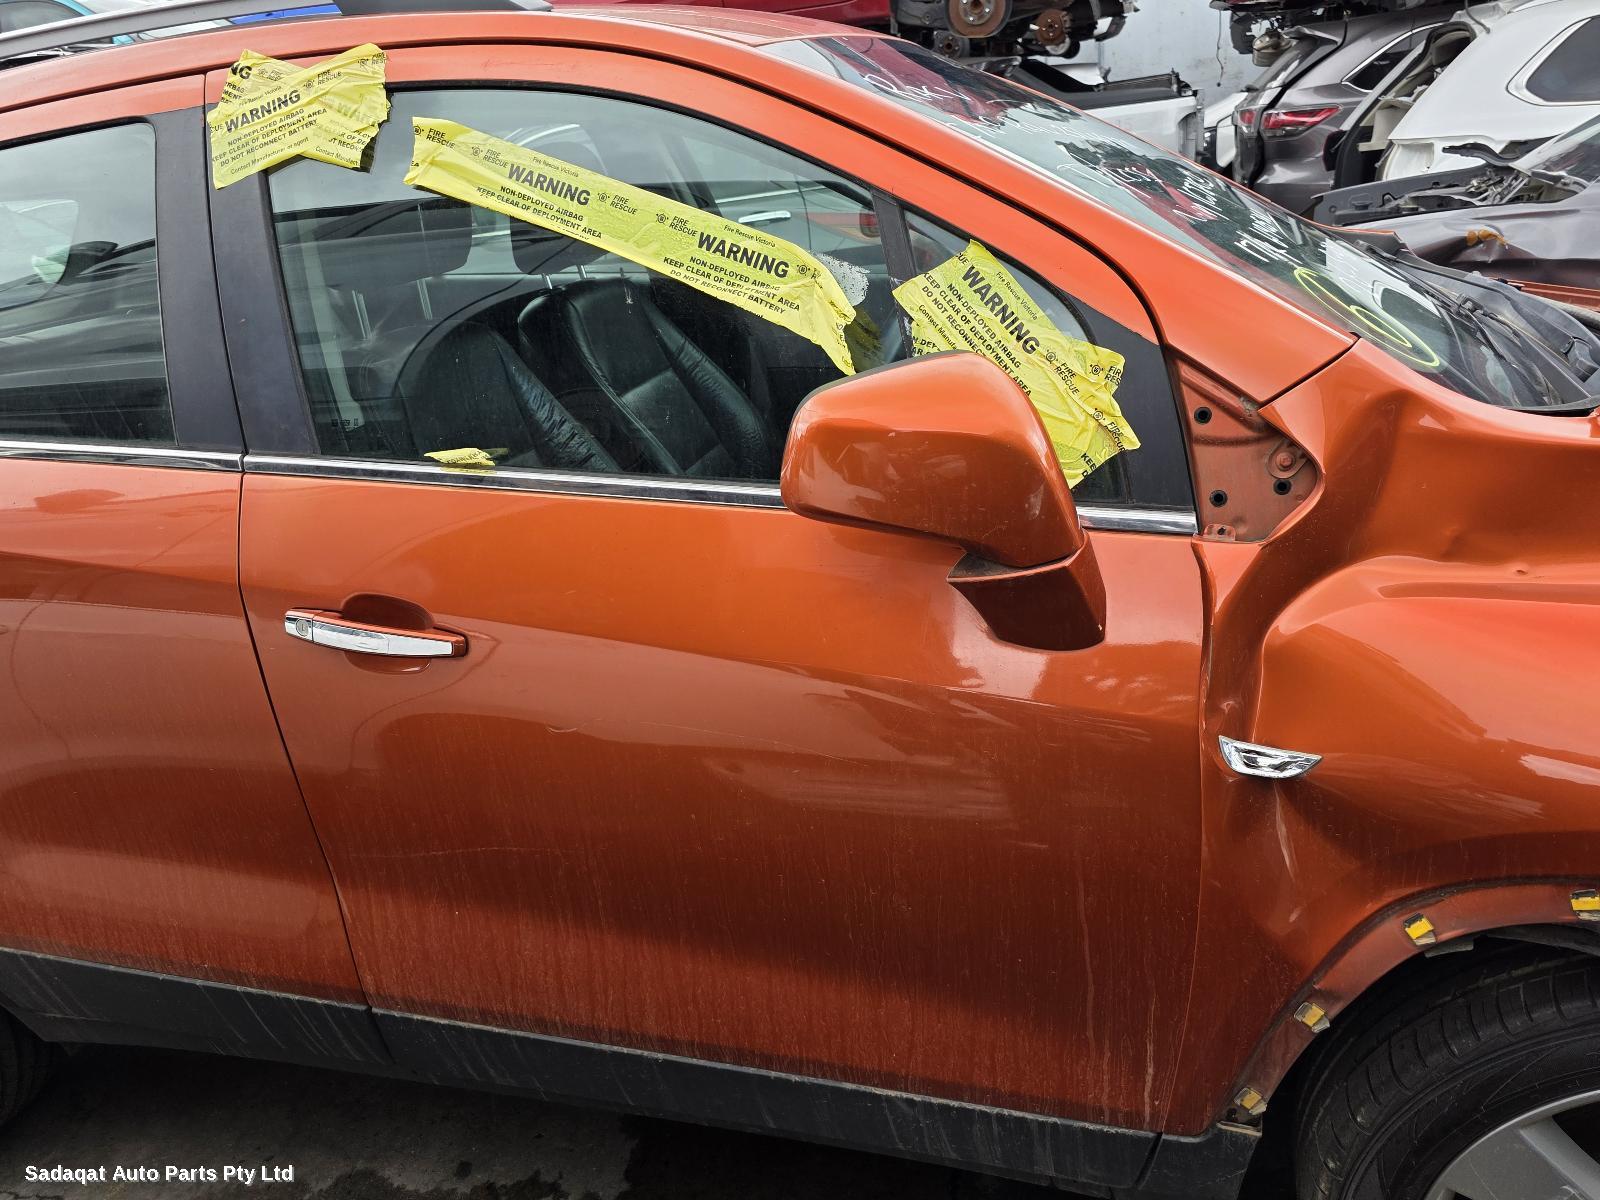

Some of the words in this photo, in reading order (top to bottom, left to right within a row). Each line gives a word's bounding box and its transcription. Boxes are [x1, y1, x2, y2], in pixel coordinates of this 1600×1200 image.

[226, 82, 246, 94] RBAG
[317, 69, 331, 80] FIRE
[317, 72, 342, 86] RESCUE
[225, 89, 301, 133] WARNING
[228, 120, 278, 147] NON-DEPLOYED
[279, 108, 304, 123] AIRBAG
[228, 141, 250, 154] CLEAR
[262, 116, 305, 140] DEPLOYMENT
[307, 108, 327, 119] AREA
[426, 134, 456, 149] RESCUE
[428, 128, 446, 139] FIRE
[220, 159, 230, 167] DO
[231, 152, 245, 162] NOT
[246, 133, 286, 155] RECONNECT
[288, 120, 317, 136] BATTERY
[230, 163, 251, 174] Contact
[251, 147, 286, 165] Manufacturer
[293, 136, 309, 147] agent
[315, 146, 335, 158] Contact
[485, 149, 501, 159] FIRE
[483, 155, 509, 168] RESCUE
[543, 160, 559, 170] Rescue
[560, 166, 579, 178] Victoria
[508, 163, 590, 205] WARNING
[501, 185, 554, 211] NON-DEPLOYED
[555, 208, 584, 221] AIRBAG
[610, 201, 638, 215] RESCUE
[613, 194, 630, 205] FIRE
[496, 194, 520, 208] CLEAR
[521, 203, 532, 211] OF
[532, 207, 581, 231] DEPLOYMENT
[581, 226, 602, 239] AREA
[669, 222, 698, 237] RESCUE
[672, 215, 690, 227] FIRE
[723, 224, 735, 233] Fire
[735, 228, 755, 240] Rescue
[755, 236, 776, 248] Victoria
[698, 231, 790, 278] WARNING
[663, 256, 685, 268] KEEP
[685, 265, 712, 280] CLEAR
[713, 275, 724, 283] OF
[777, 297, 800, 312] AREA
[690, 256, 750, 283] NON-DEPLOYED
[751, 279, 780, 291] AIRBAG
[670, 269, 682, 277] DO
[682, 273, 700, 284] NOT
[701, 280, 748, 298] RECONNECT
[747, 294, 786, 315] BATTERY
[922, 285, 934, 298] DO
[931, 297, 949, 314] NOT
[996, 271, 1005, 282] Fire
[1004, 281, 1020, 300] Rescue
[1020, 298, 1038, 320] Victoria
[919, 304, 939, 329] Contact
[962, 264, 1040, 355] WARNING
[947, 283, 996, 340] NON-DEPLOYED
[995, 339, 1021, 369] AIRBAG
[939, 290, 961, 315] CLEAR
[960, 314, 972, 325] OF
[969, 325, 1014, 375] DEPLOYMENT
[1013, 375, 1032, 397] AREA
[1054, 366, 1080, 395] RESCUE
[1060, 362, 1077, 380] FIRE
